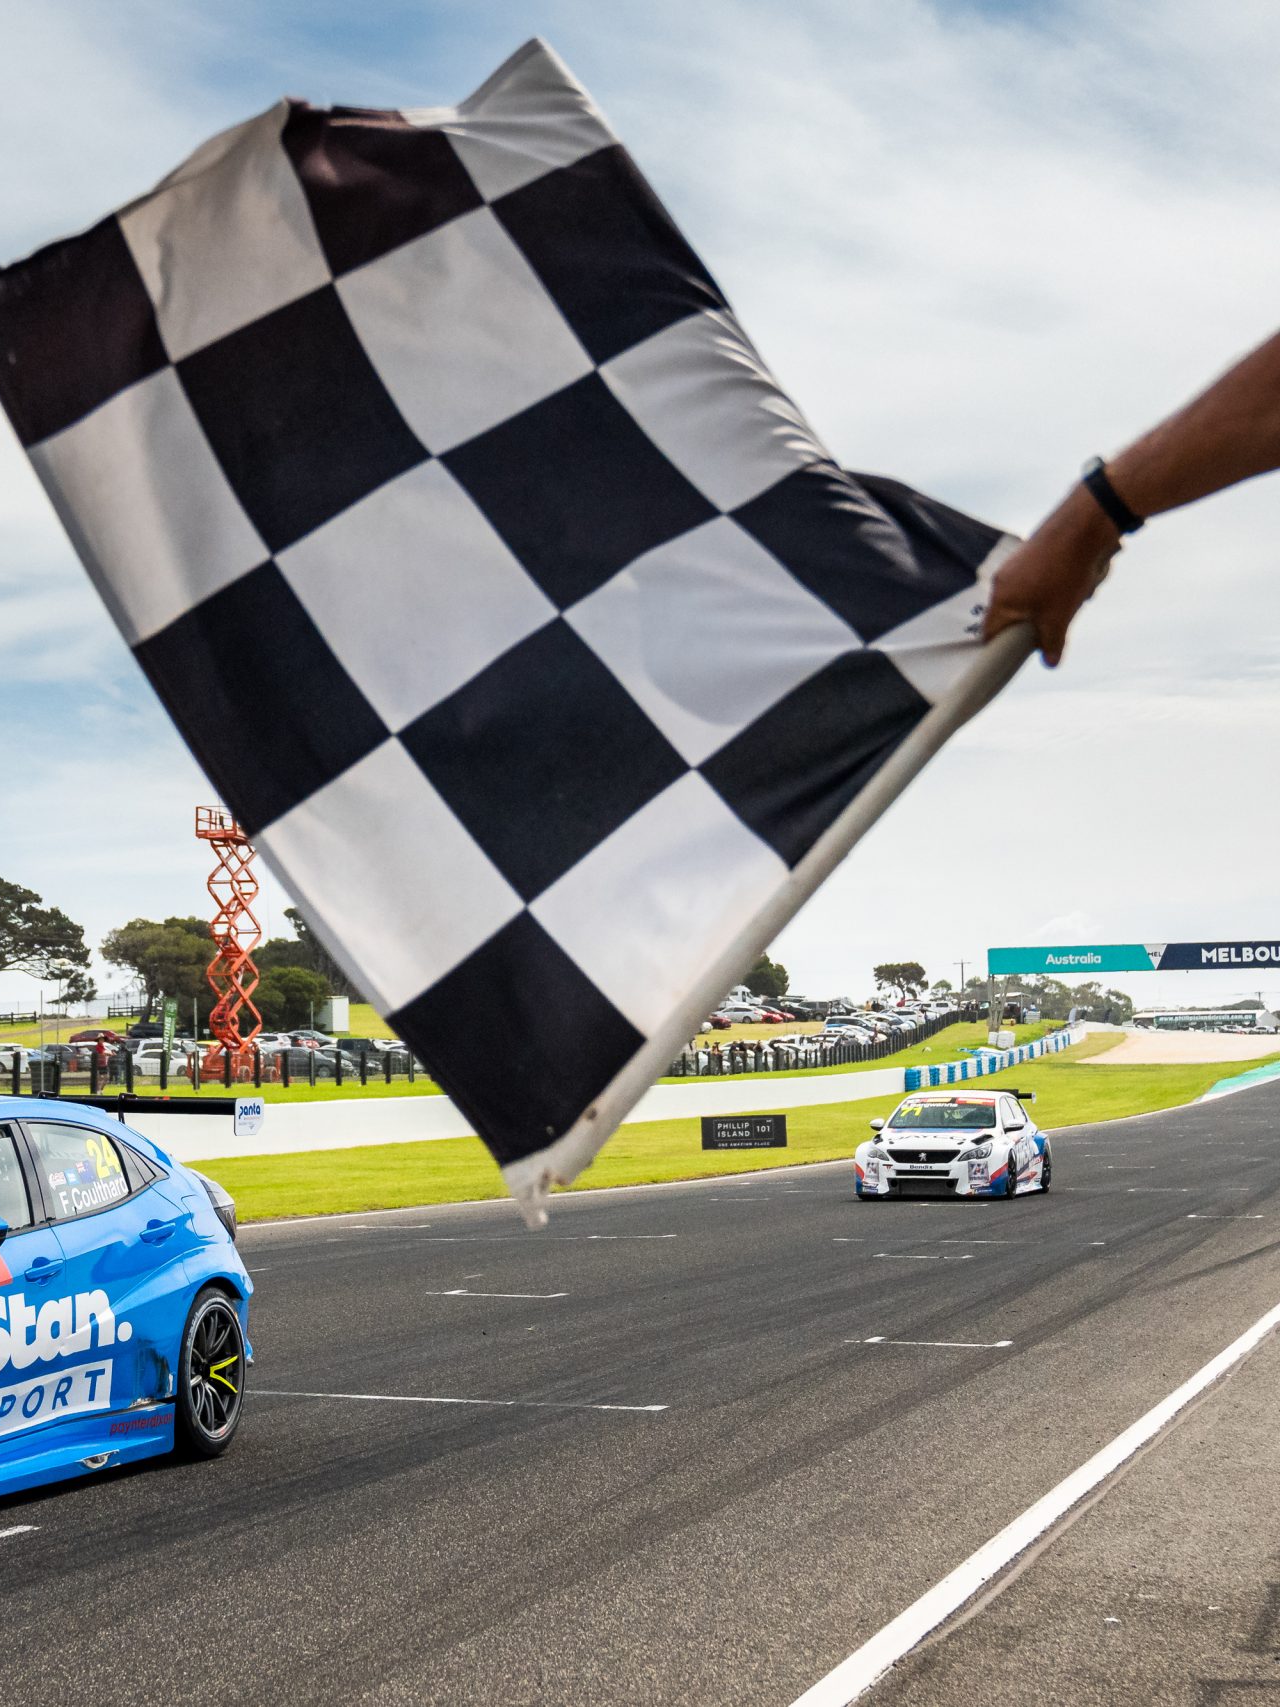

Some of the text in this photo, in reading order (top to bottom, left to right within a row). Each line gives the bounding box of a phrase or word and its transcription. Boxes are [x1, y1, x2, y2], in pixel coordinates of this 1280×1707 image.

[1045, 952, 1102, 965] Australia
[1201, 946, 1280, 963] MELBOU
[238, 1103, 261, 1119] panta
[900, 1107, 922, 1116] 71
[717, 1122, 750, 1130] PHILLIP
[717, 1130, 750, 1138] ISLAND
[86, 1135, 120, 1179] 24
[59, 1171, 129, 1214] F.Coulthard
